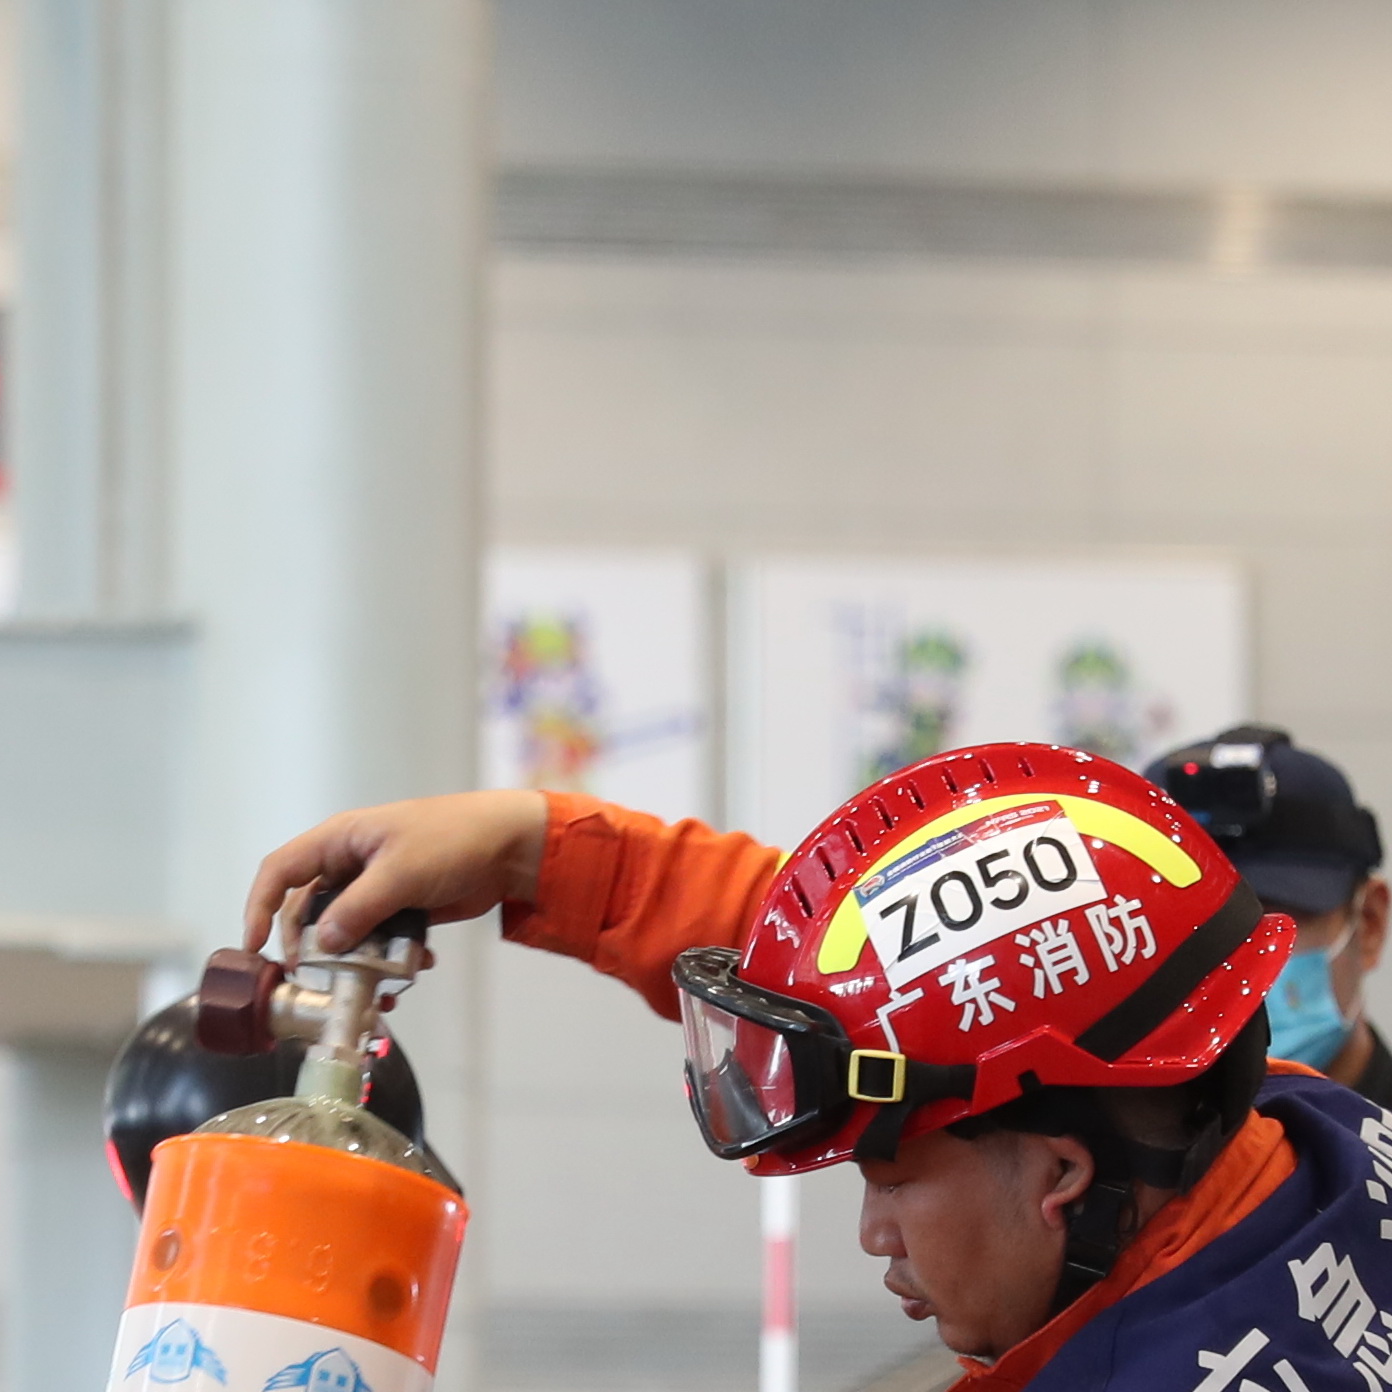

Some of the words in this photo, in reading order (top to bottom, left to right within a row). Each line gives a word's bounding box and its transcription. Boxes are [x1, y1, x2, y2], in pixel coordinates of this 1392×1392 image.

[879, 836, 1077, 963] Z050
[876, 894, 1157, 1053] 广东消防
